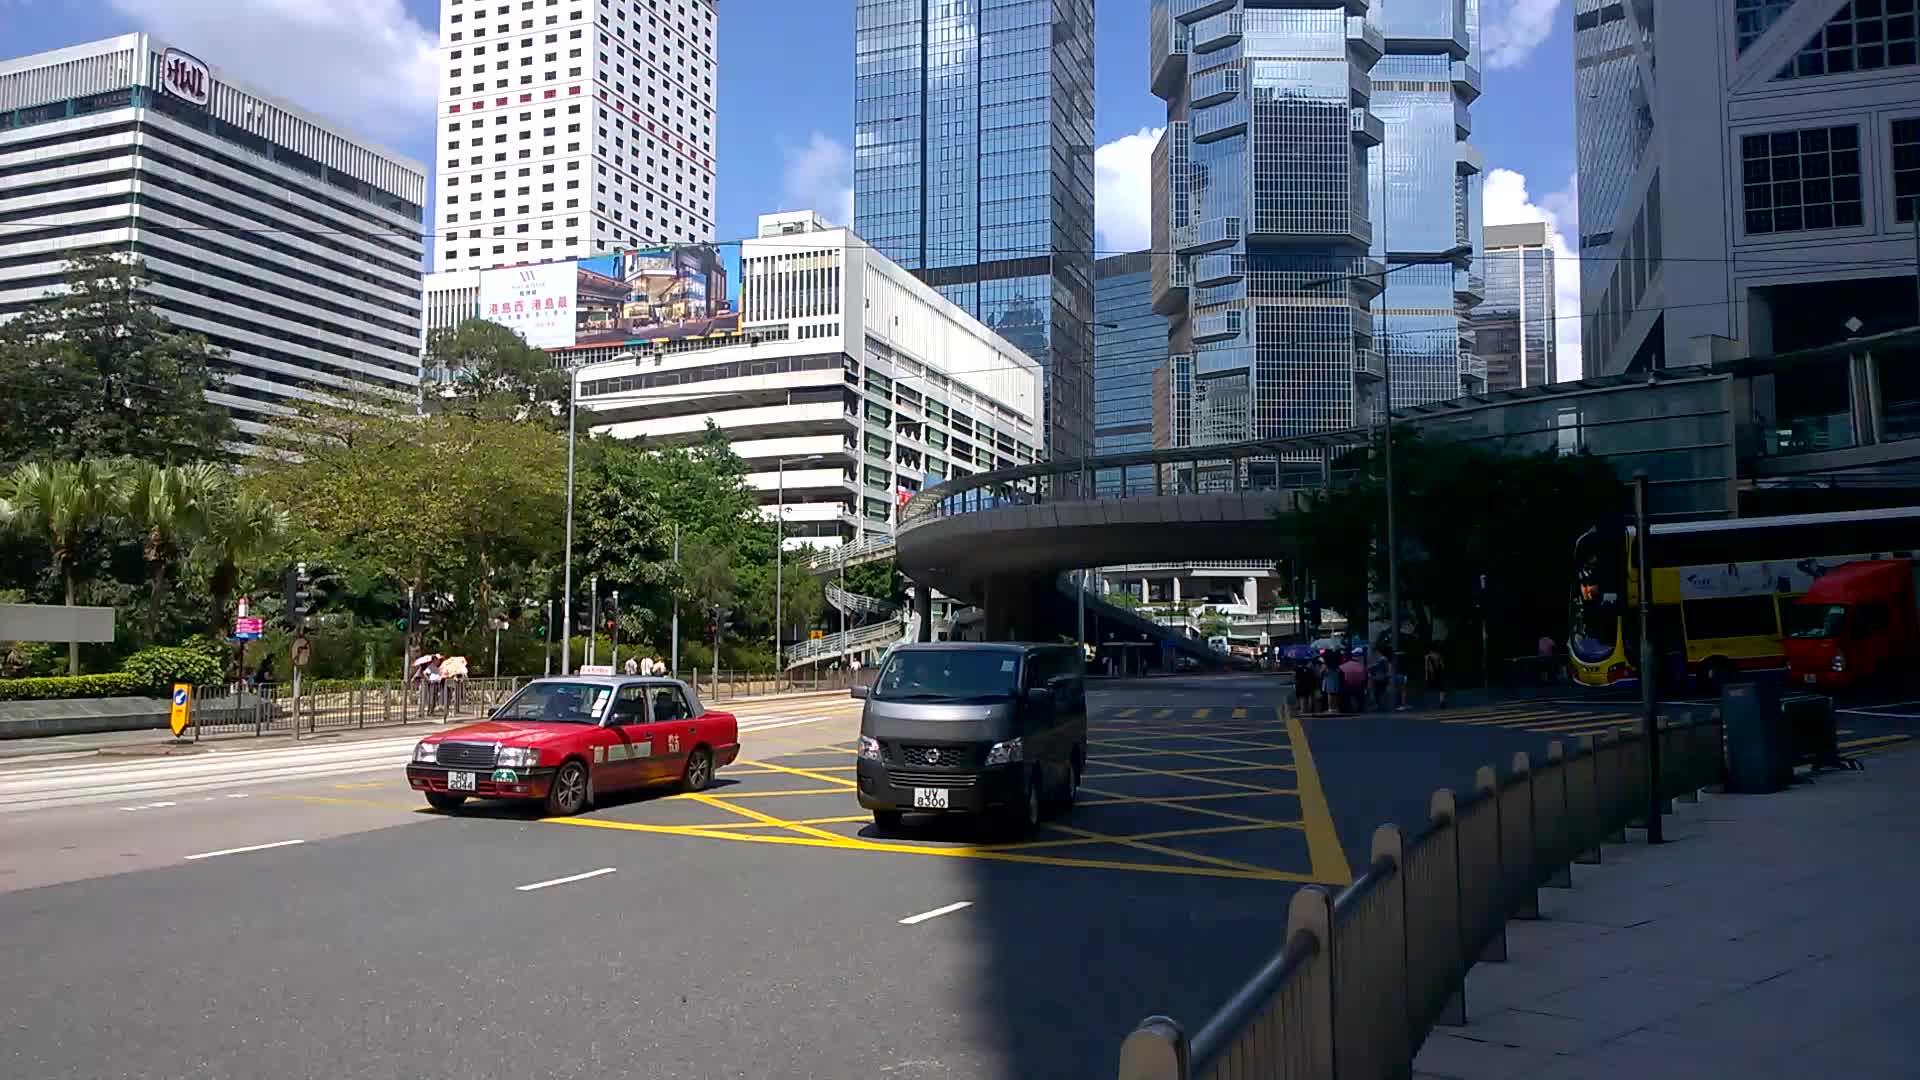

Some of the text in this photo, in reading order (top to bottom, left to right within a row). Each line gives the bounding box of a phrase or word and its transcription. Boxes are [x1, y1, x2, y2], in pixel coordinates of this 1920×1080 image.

[167, 58, 206, 98] HWL
[924, 788, 939, 799] UV
[917, 797, 946, 808] 8300
